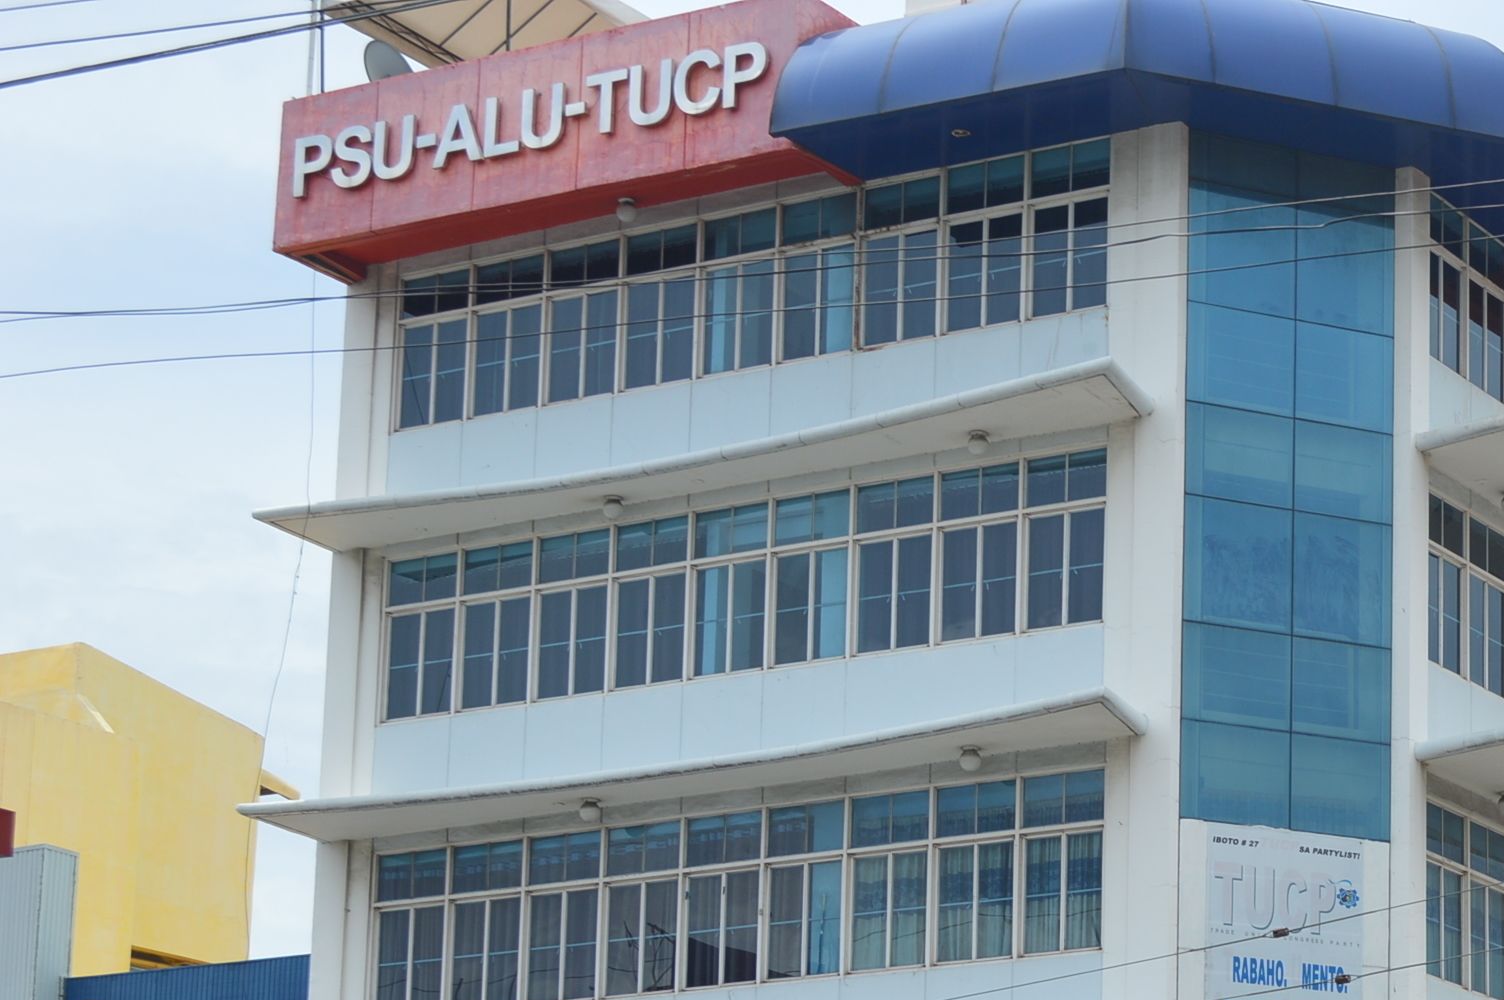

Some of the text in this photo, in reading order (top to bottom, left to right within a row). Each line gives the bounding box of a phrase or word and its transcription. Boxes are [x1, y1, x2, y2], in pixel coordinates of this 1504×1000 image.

[292, 41, 771, 199] PSU-ALU-TUCP
[1212, 836, 1240, 846] IBOTO
[1248, 840, 1260, 848] 27
[1299, 846, 1311, 854] SA
[1213, 860, 1337, 936] TUCP
